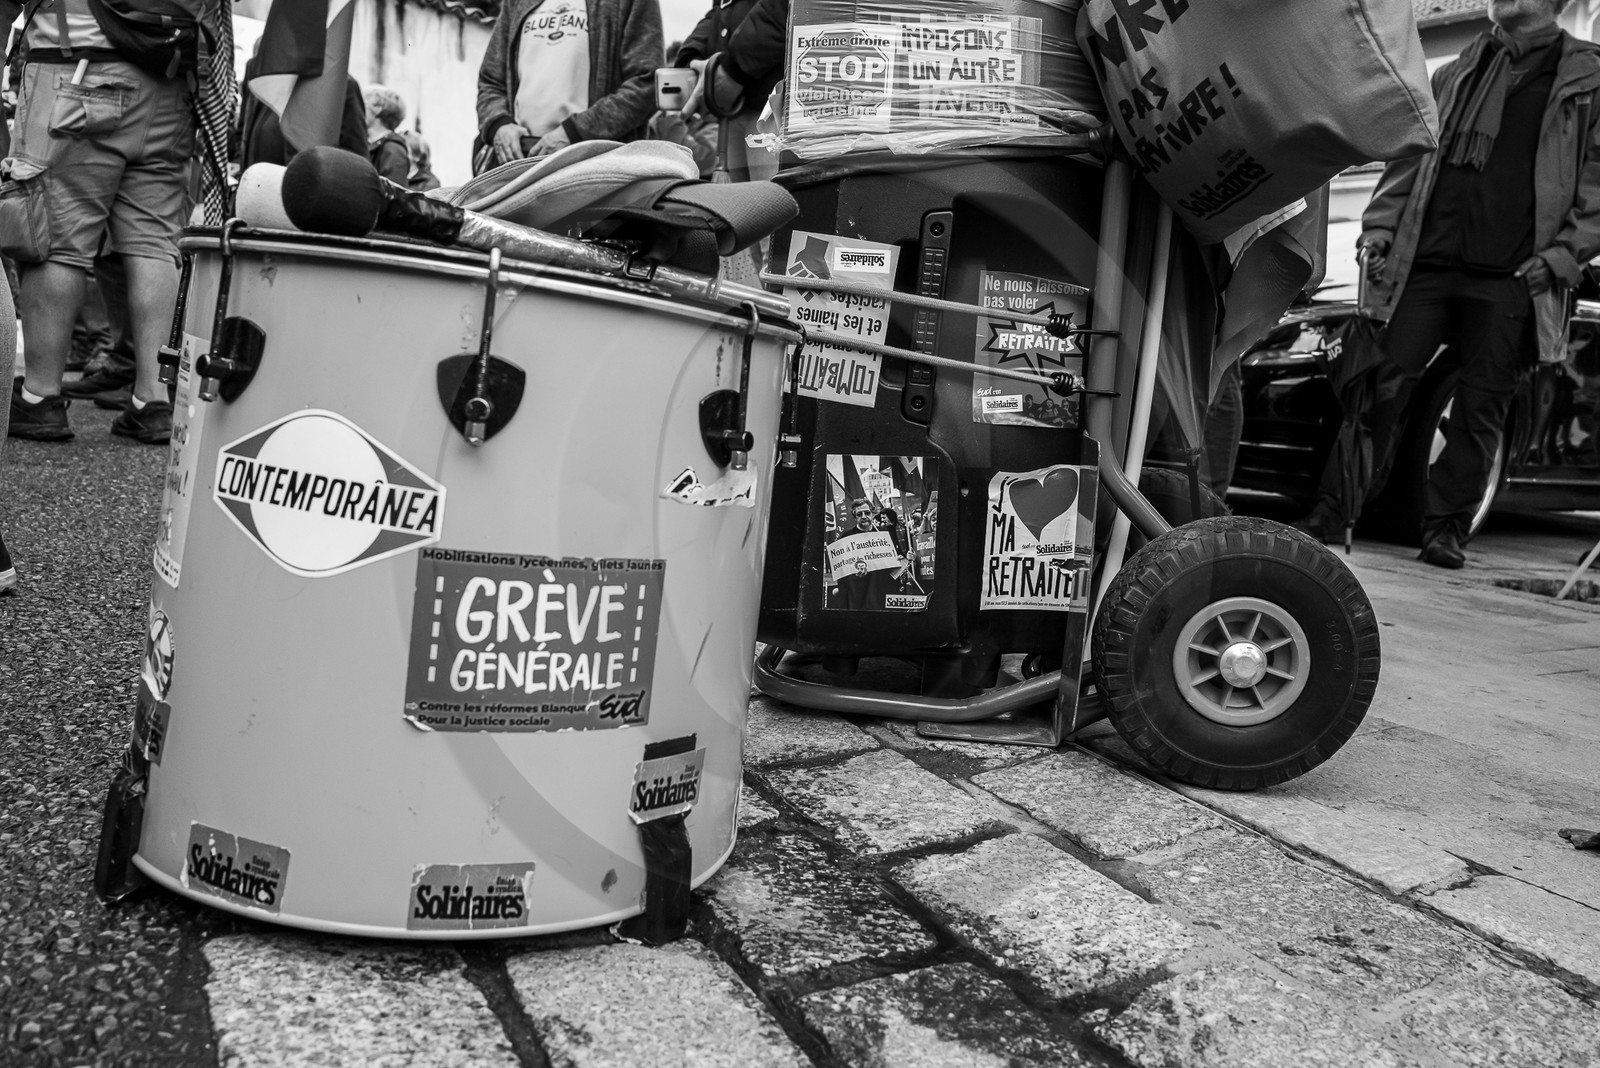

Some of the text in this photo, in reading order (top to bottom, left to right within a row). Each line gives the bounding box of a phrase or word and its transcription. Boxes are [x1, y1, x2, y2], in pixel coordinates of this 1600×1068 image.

[524, 16, 557, 34] BLUE
[797, 34, 890, 48] Extrême droite
[799, 55, 886, 83] STOP
[912, 57, 1015, 83] UN AUTRE
[1118, 66, 1169, 138] PAS
[1177, 156, 1266, 218] Solidaires
[840, 253, 885, 267] Solidaires
[984, 275, 1085, 296] Ne nous laissons
[983, 294, 1039, 310] pas voler
[796, 307, 882, 336] et les haines
[986, 399, 1018, 409] Solidaires
[218, 457, 438, 532] CONTEMPORÂNEA
[990, 513, 1015, 555] MA
[422, 549, 516, 566] Mobilisations
[626, 558, 663, 573] jaunes
[830, 545, 845, 559] Non
[864, 551, 892, 561] richesses
[1036, 543, 1073, 555] Solidaires
[455, 568, 626, 645] GRÈVE
[886, 597, 926, 608] Solidaires
[449, 642, 625, 694] GÉNÉRALE
[418, 701, 461, 712] Contre
[464, 703, 482, 713] les
[484, 703, 539, 713] réformes
[417, 714, 550, 728] Pour la justice sociale
[634, 774, 699, 813] Solidaires
[188, 843, 278, 906] Solidaires
[414, 884, 525, 920] Solidaires
